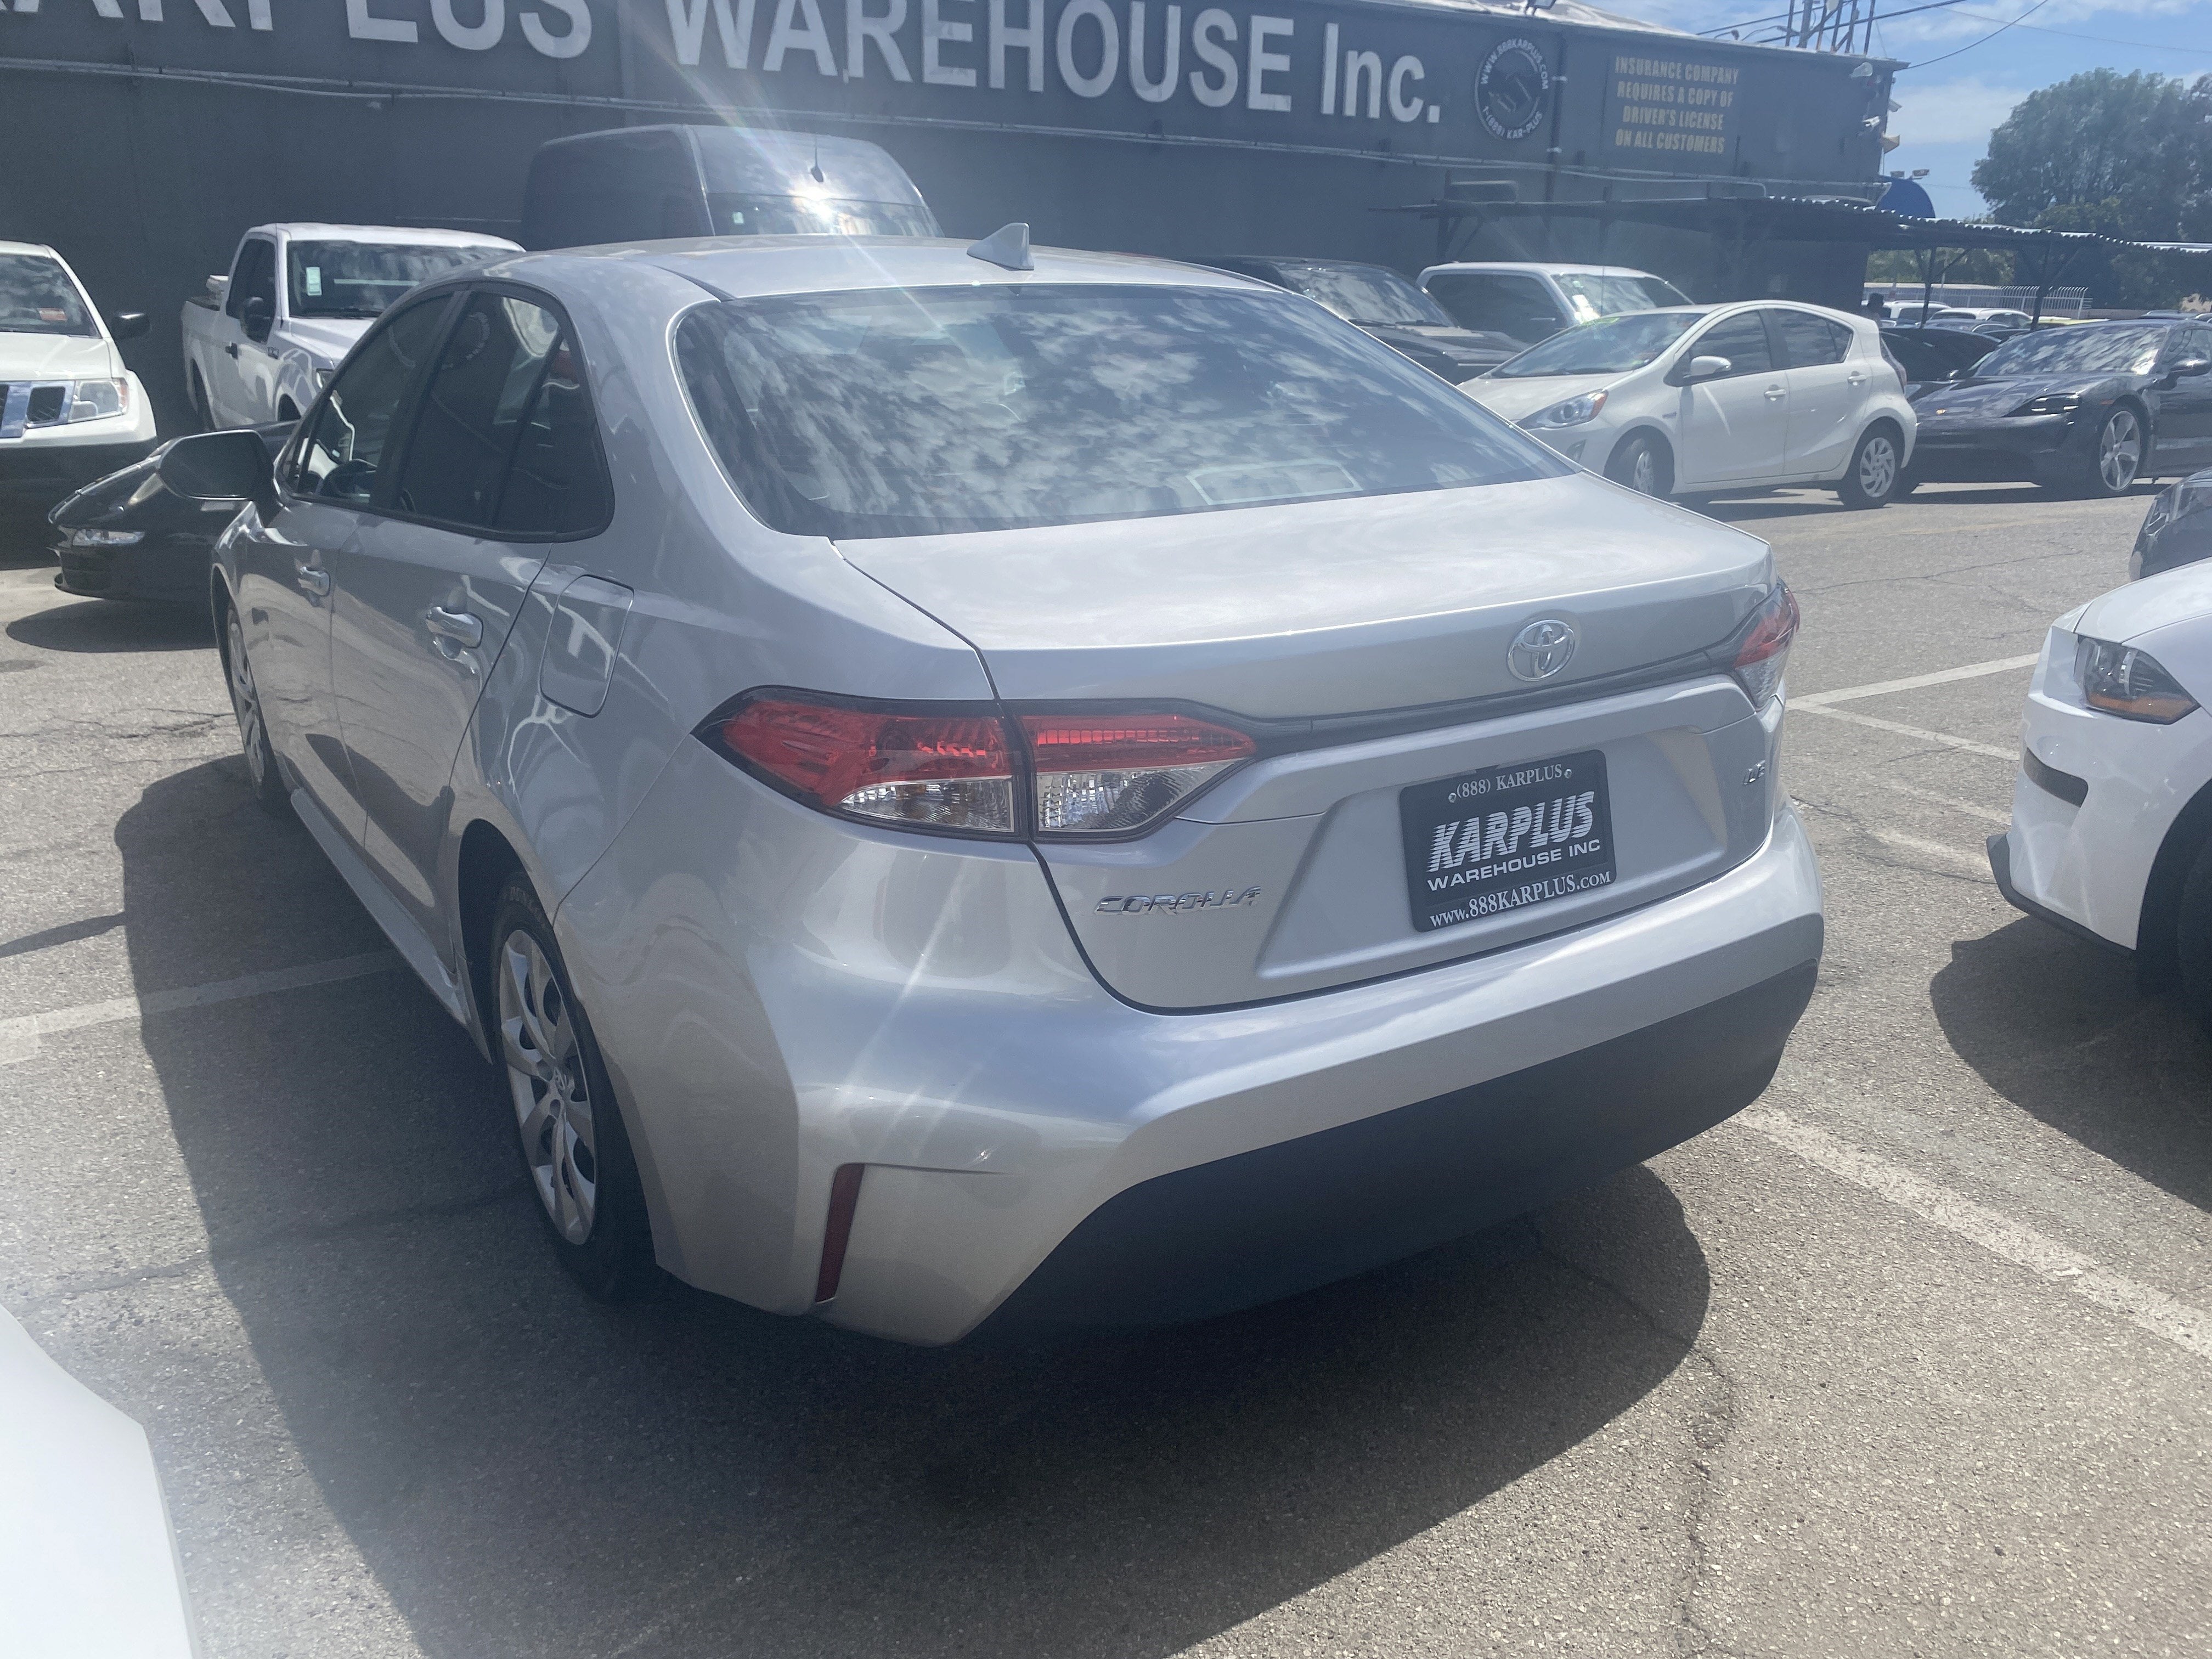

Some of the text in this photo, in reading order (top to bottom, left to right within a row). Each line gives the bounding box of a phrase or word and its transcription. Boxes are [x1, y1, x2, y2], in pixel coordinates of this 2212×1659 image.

[665, 0, 1294, 112] WAREHOUSE
[1321, 22, 1441, 123] Inc.
[1615, 56, 1739, 84] INSURANCE COMPANY
[1617, 81, 1734, 108] REQUIRES A COPY OF
[1622, 105, 1724, 131] DRIVER'S LICENSE
[1615, 128, 1725, 154] ON ALL CUSTOMERS
[1456, 764, 1562, 798] (888) KARPLUS
[1426, 790, 1595, 873] KARPLUS
[1427, 839, 1601, 892] WAREHOUSE INC
[1094, 885, 1261, 915] COROLLA
